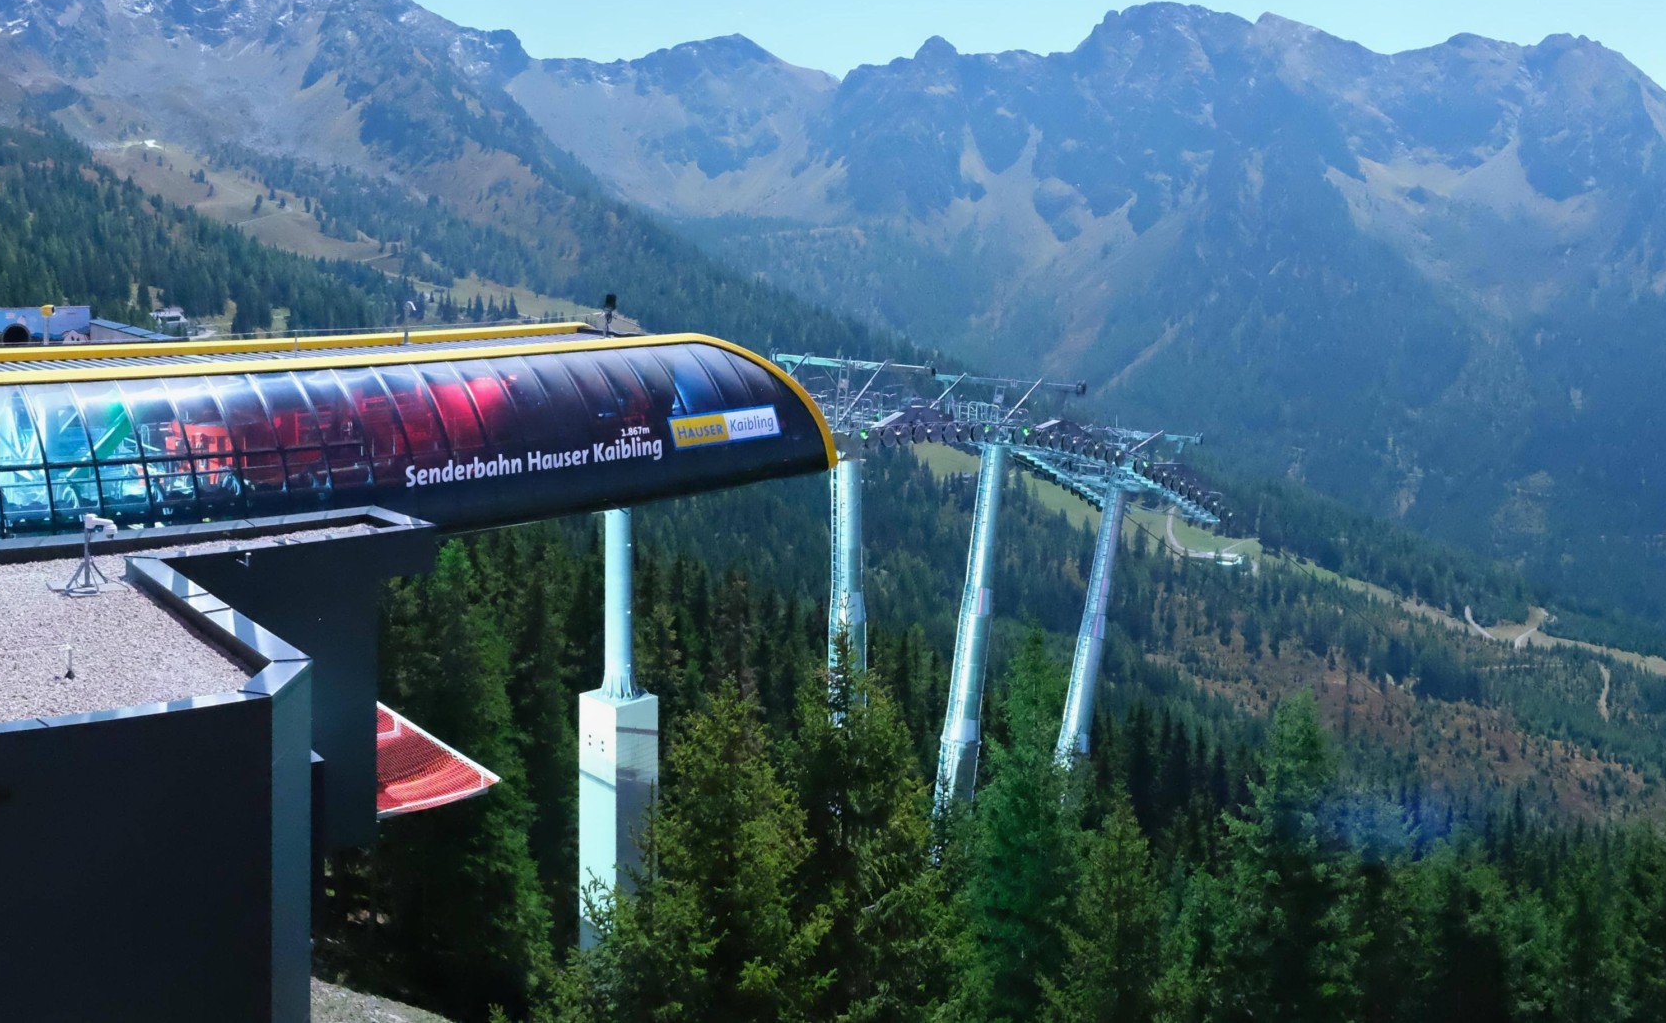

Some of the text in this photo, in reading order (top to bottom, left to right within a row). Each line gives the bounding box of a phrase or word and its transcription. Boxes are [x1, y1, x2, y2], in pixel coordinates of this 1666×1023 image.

[621, 426, 650, 437] 1.867m
[677, 415, 774, 439] HAUSER Kaibling
[405, 437, 663, 488] Senderbahn Hauser Kaibling
